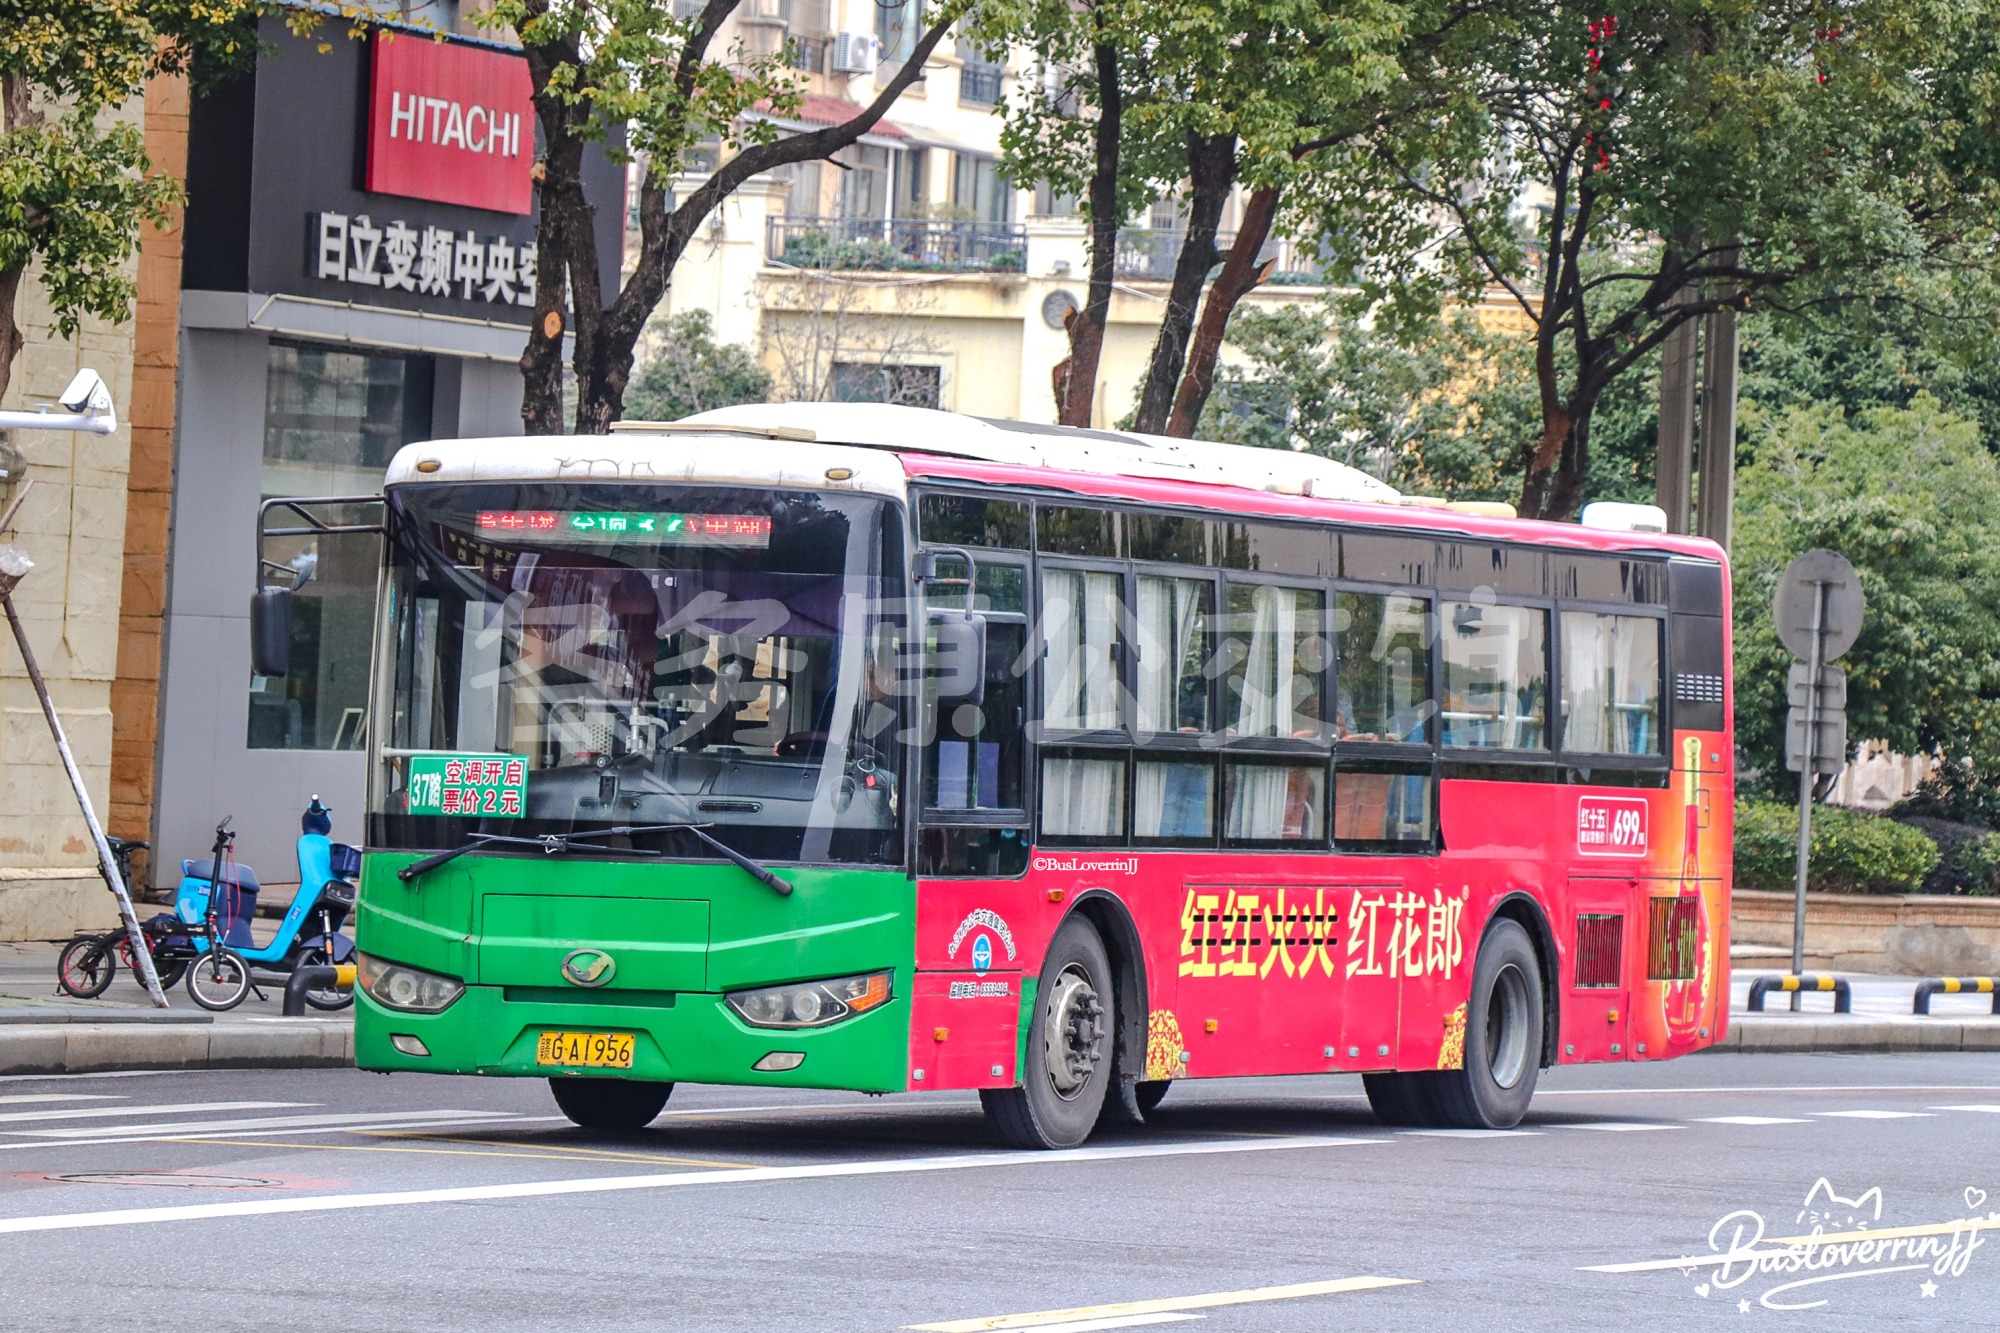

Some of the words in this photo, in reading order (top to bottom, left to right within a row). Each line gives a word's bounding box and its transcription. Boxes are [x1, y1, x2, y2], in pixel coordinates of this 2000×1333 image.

[390, 91, 519, 157] HITACHI
[318, 211, 574, 312] 日立变频中央空
[411, 772, 441, 807] 37路
[444, 761, 523, 786] 空调开启
[442, 788, 520, 814] 票价2元
[1580, 807, 1606, 829] 红十五
[1179, 888, 1339, 980] 红红火火
